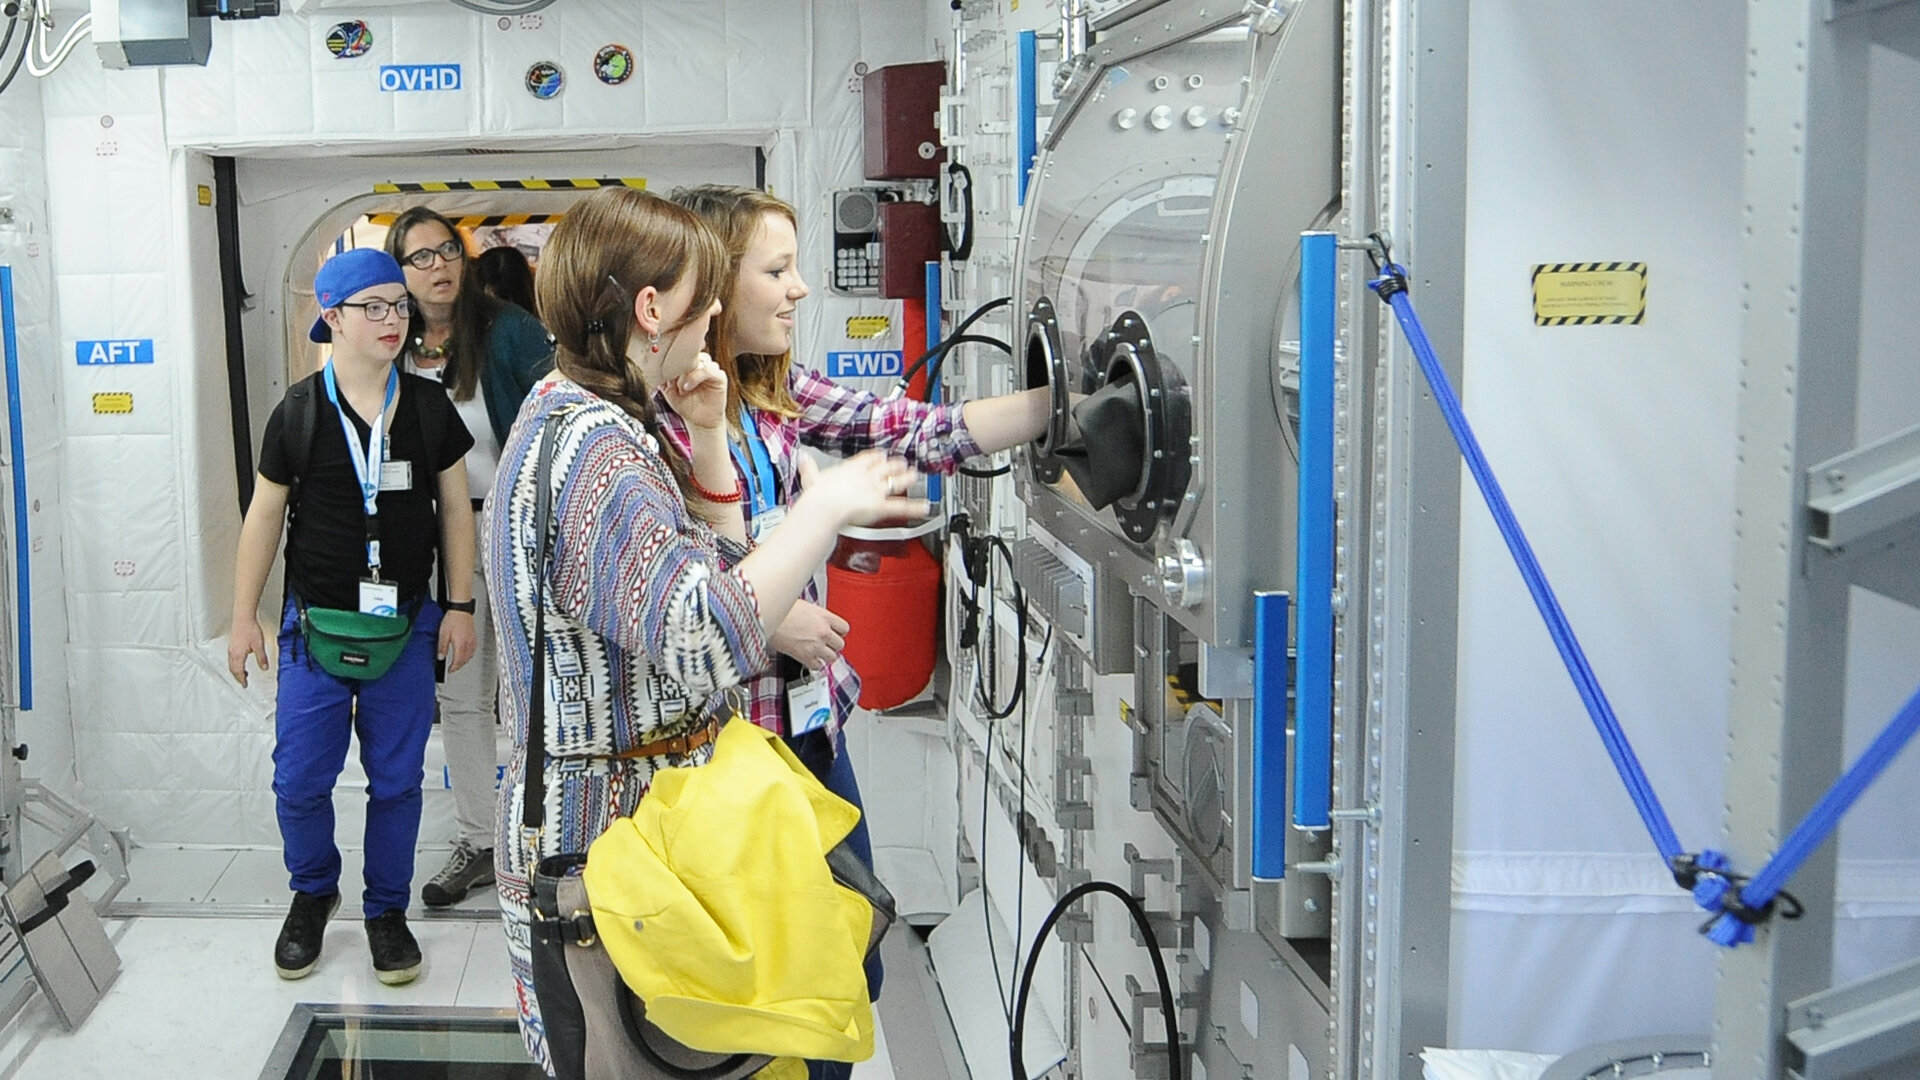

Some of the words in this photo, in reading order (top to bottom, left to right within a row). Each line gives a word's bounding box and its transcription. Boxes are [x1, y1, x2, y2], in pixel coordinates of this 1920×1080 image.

[381, 68, 458, 91] OVHD
[89, 341, 140, 364] AFT
[838, 352, 900, 375] FWD
